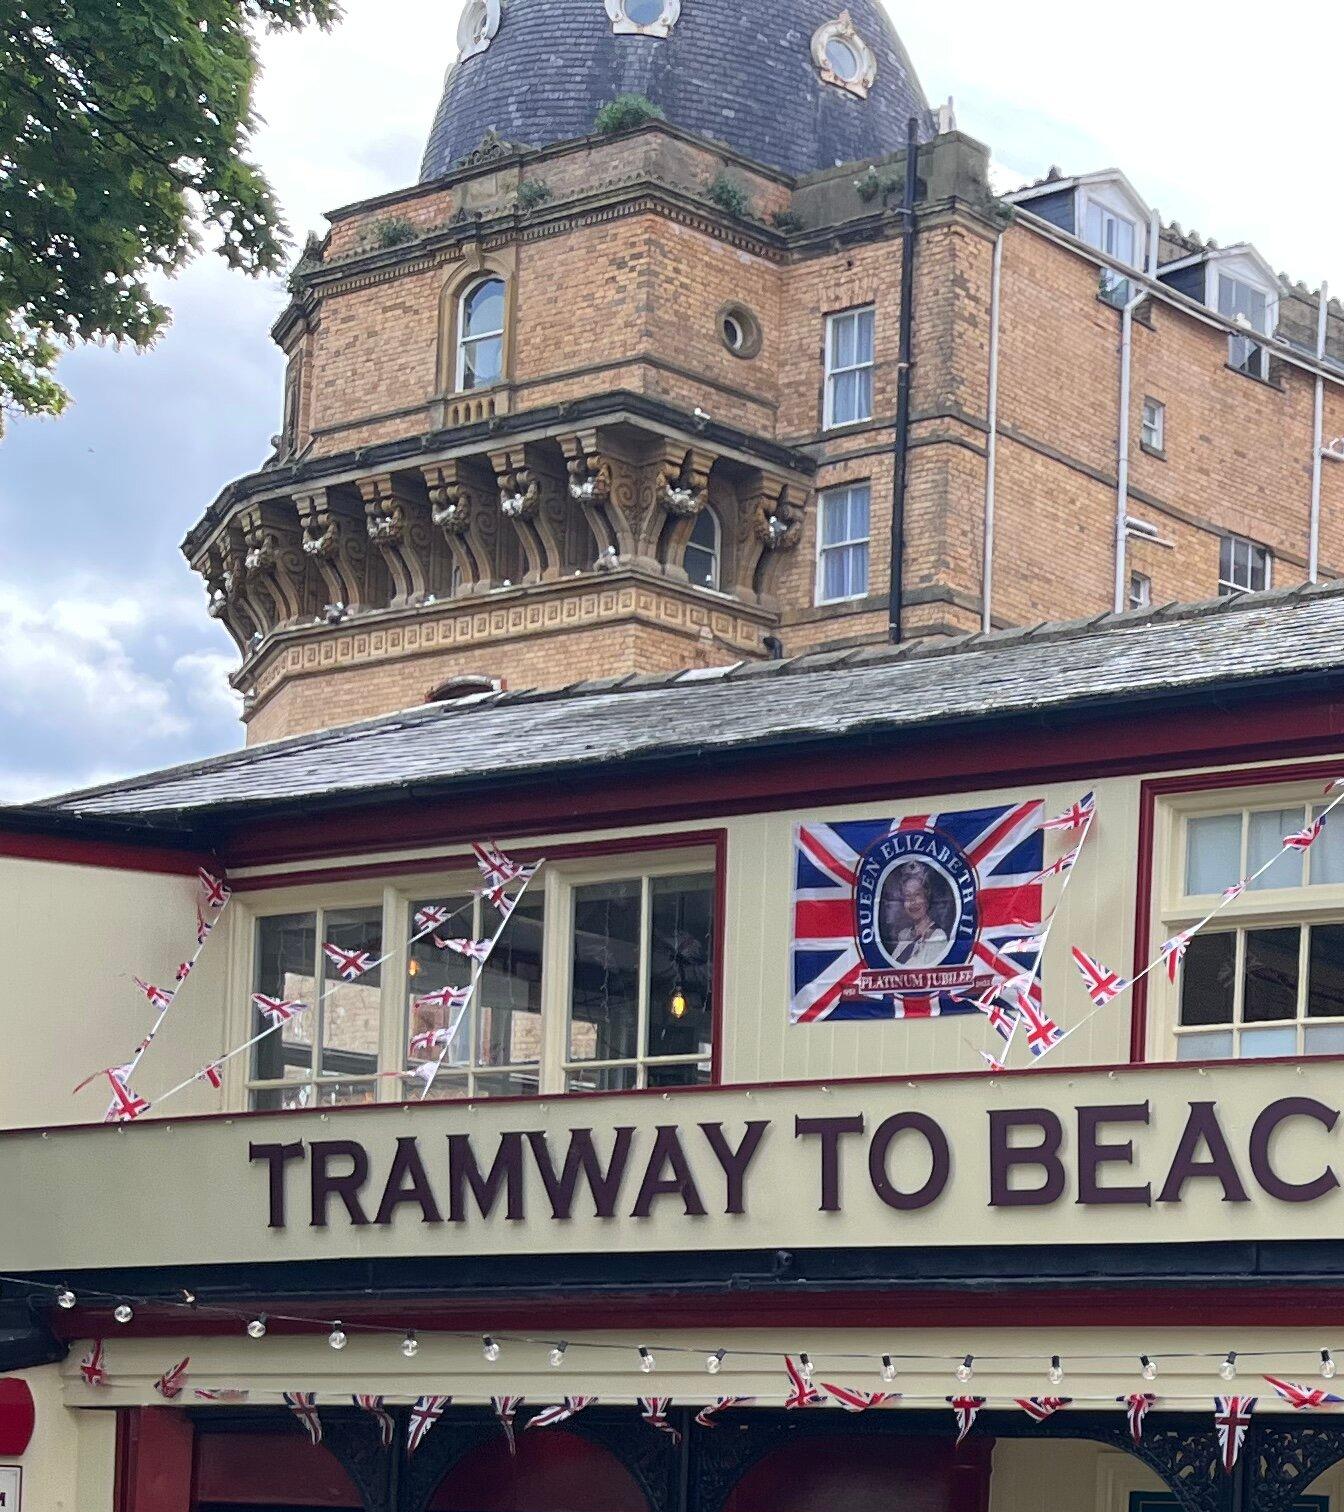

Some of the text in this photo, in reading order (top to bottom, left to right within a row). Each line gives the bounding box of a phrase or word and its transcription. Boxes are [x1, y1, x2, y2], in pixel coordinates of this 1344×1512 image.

[858, 854, 884, 944] QUEEN
[881, 833, 973, 904] ELIZABETH
[861, 969, 974, 991] PLATINUM JUBILEE
[249, 1119, 772, 1229] TRAMWAY
[794, 1112, 950, 1212] TO
